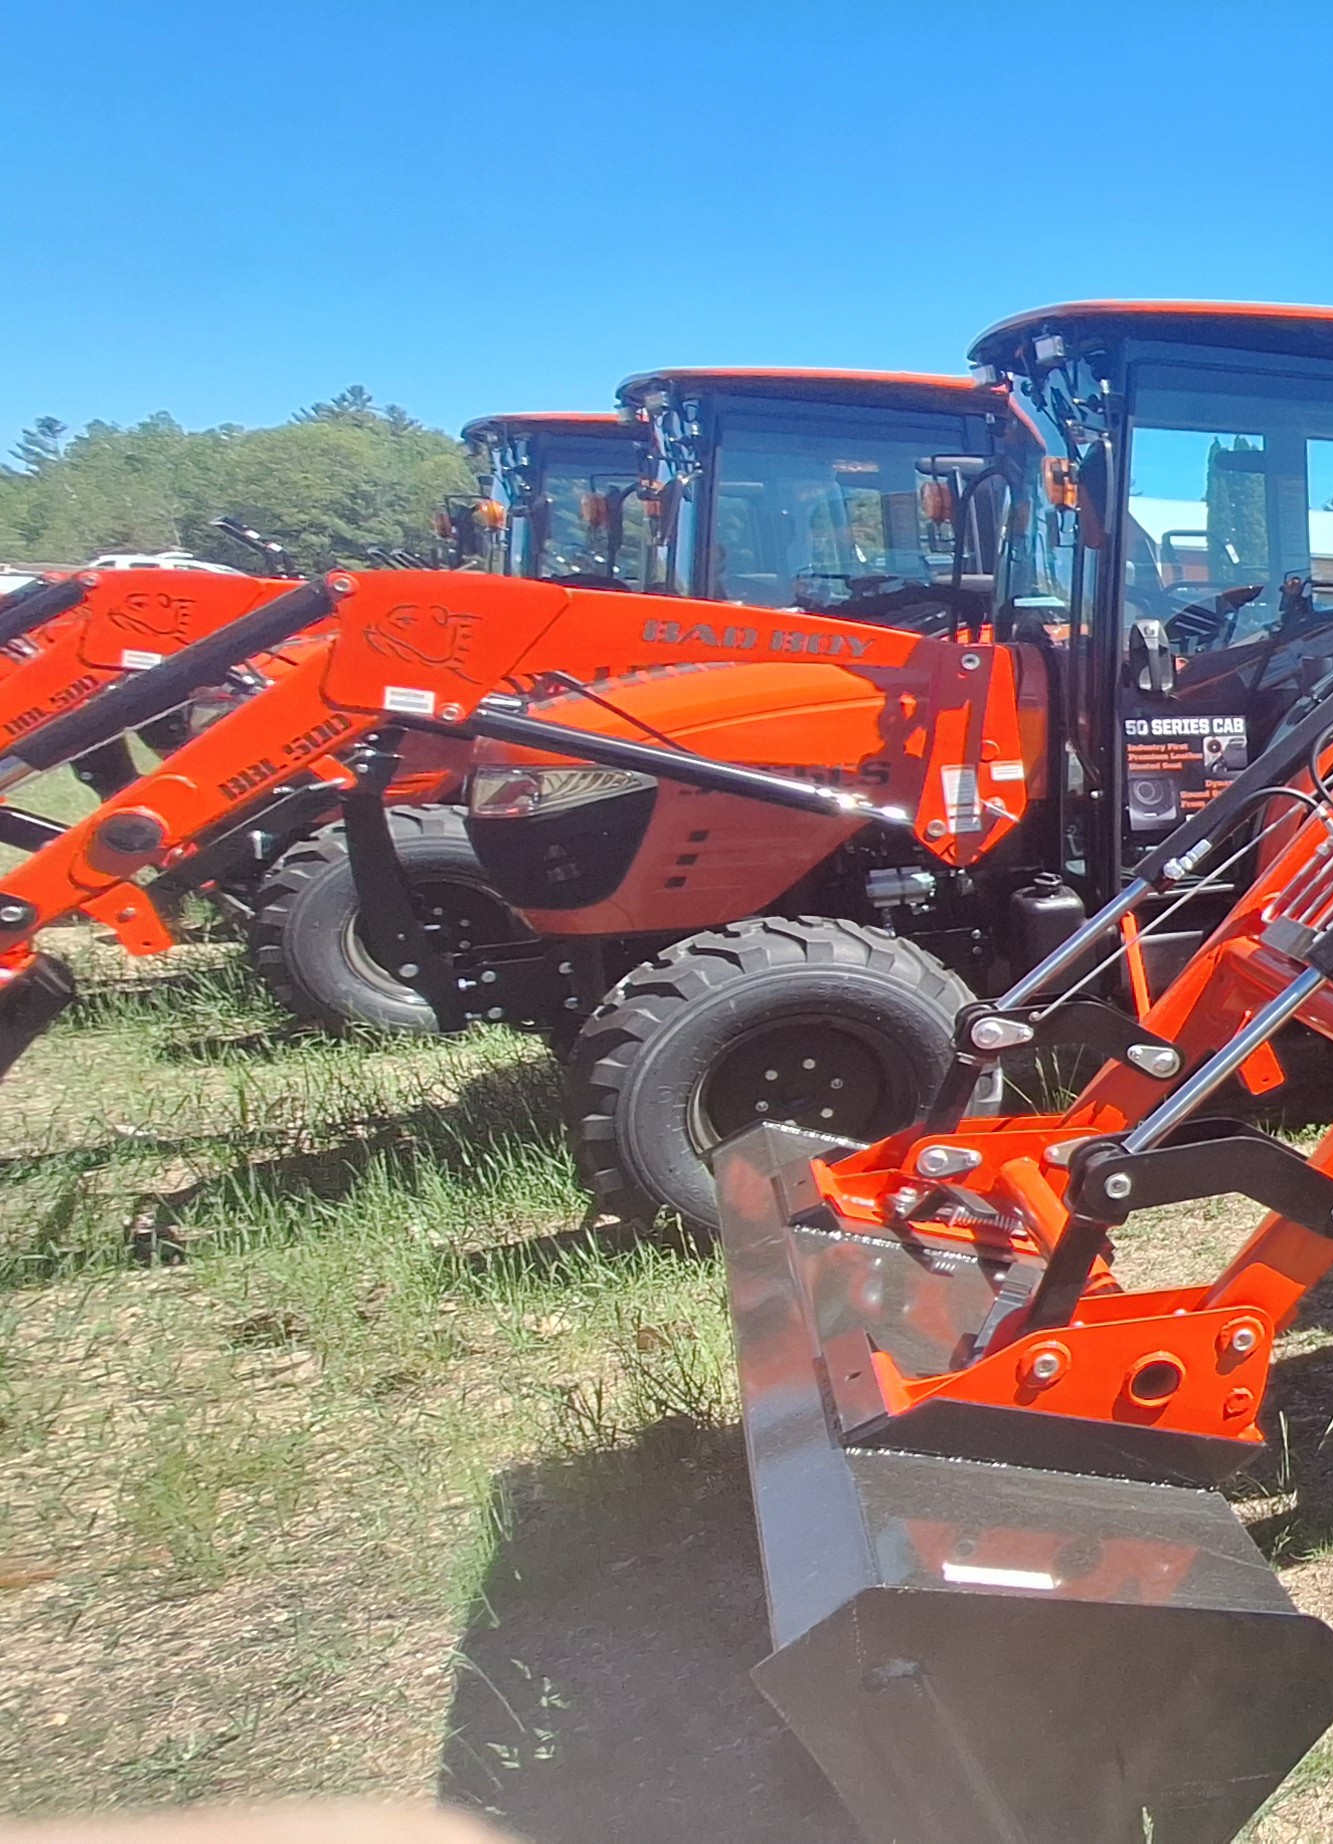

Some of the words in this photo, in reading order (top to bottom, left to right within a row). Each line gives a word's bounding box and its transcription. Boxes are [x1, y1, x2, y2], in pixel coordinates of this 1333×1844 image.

[642, 618, 759, 649] BAD
[769, 629, 876, 659] BOY
[48, 674, 101, 709] 500
[1125, 719, 1149, 736] 50
[1151, 718, 1210, 735] SERIES
[1213, 717, 1244, 733] CAB
[218, 757, 288, 801] BBL
[282, 713, 352, 761] 500
